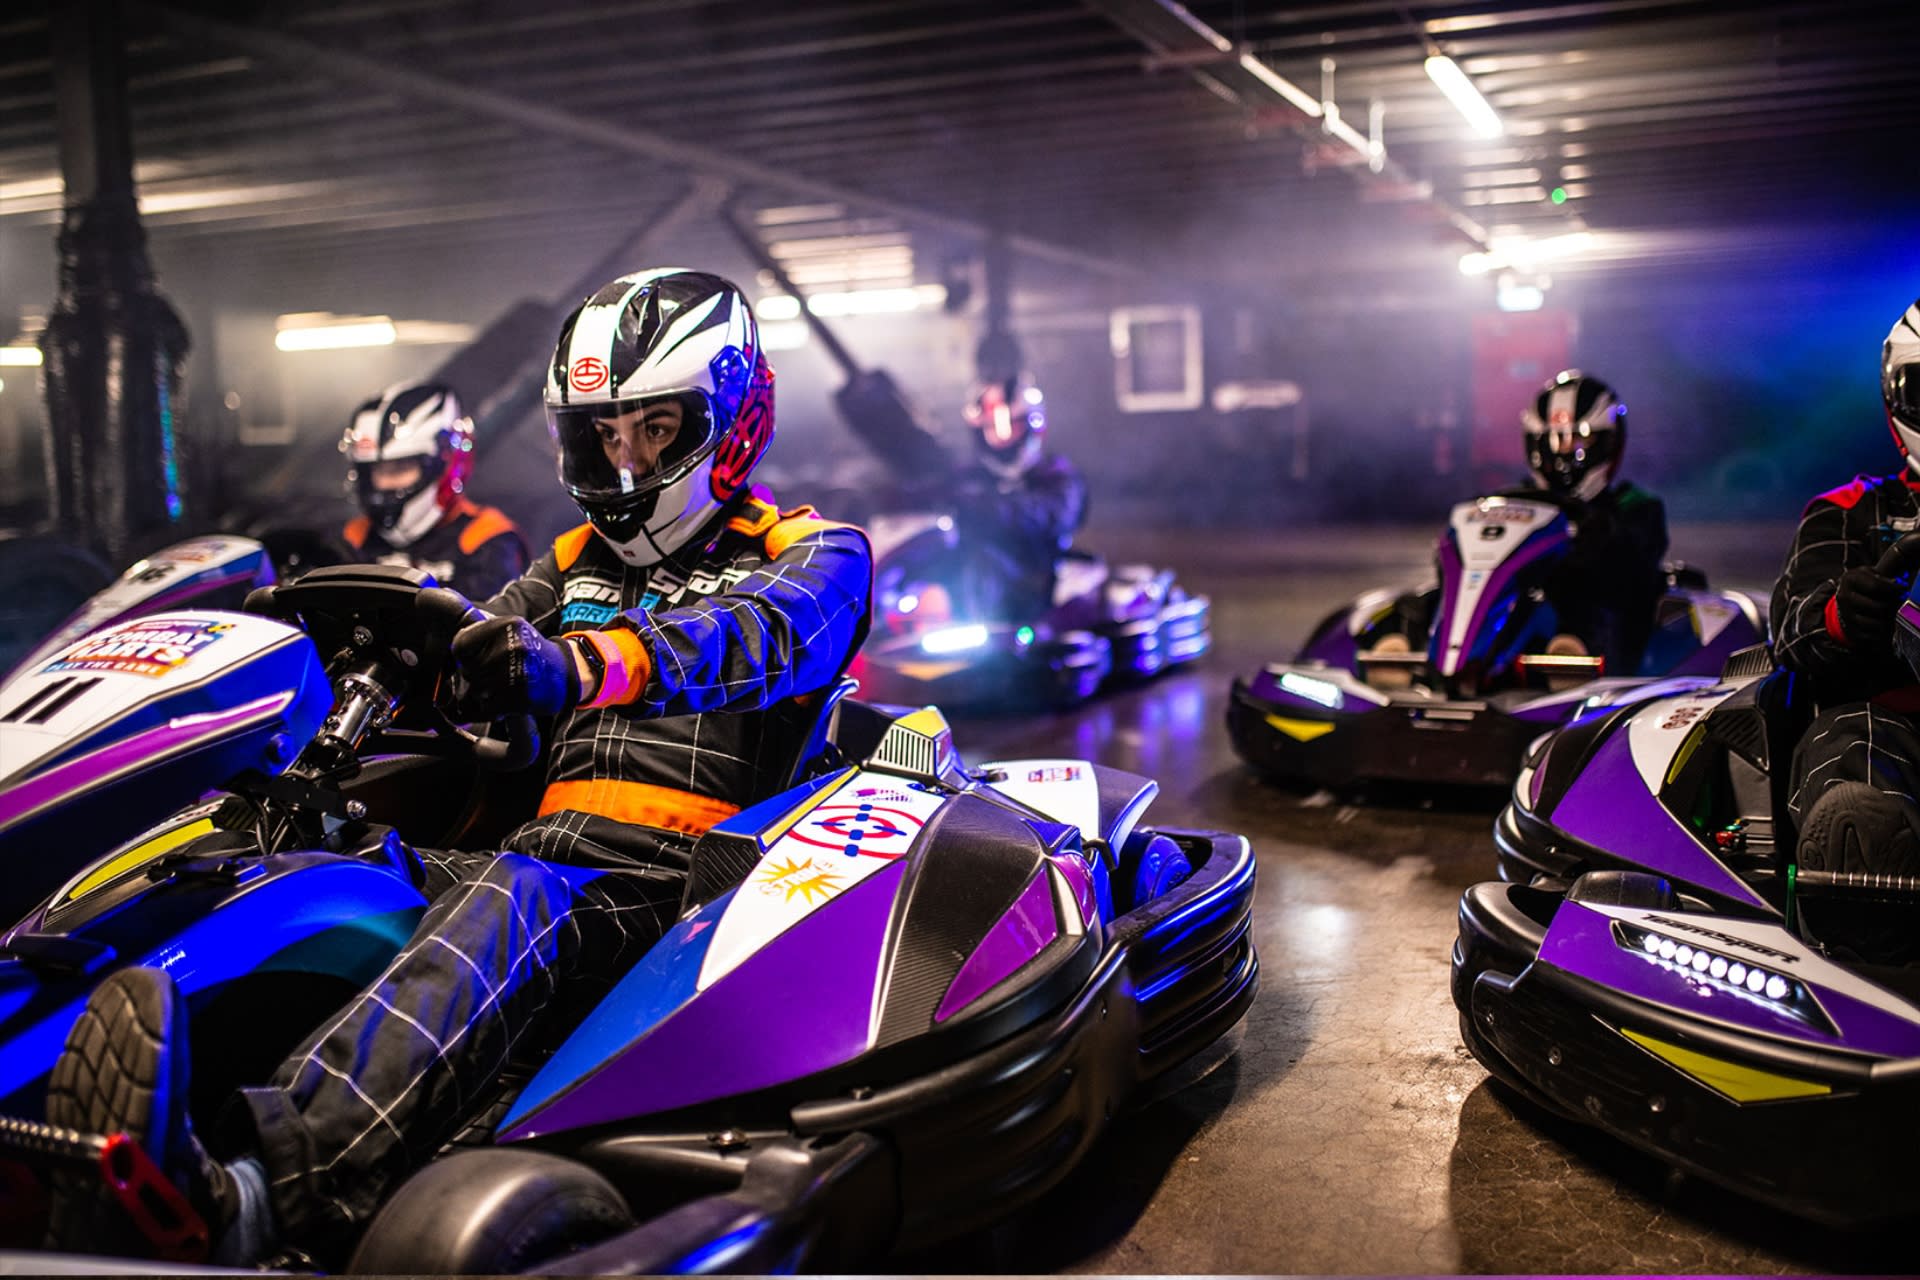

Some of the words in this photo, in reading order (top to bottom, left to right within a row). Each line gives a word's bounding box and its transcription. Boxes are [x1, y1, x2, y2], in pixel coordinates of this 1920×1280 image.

[68, 641, 195, 662] KARTS
[83, 661, 114, 670] THE
[0, 675, 105, 725] 11
[1641, 913, 1801, 964] TeamSport
